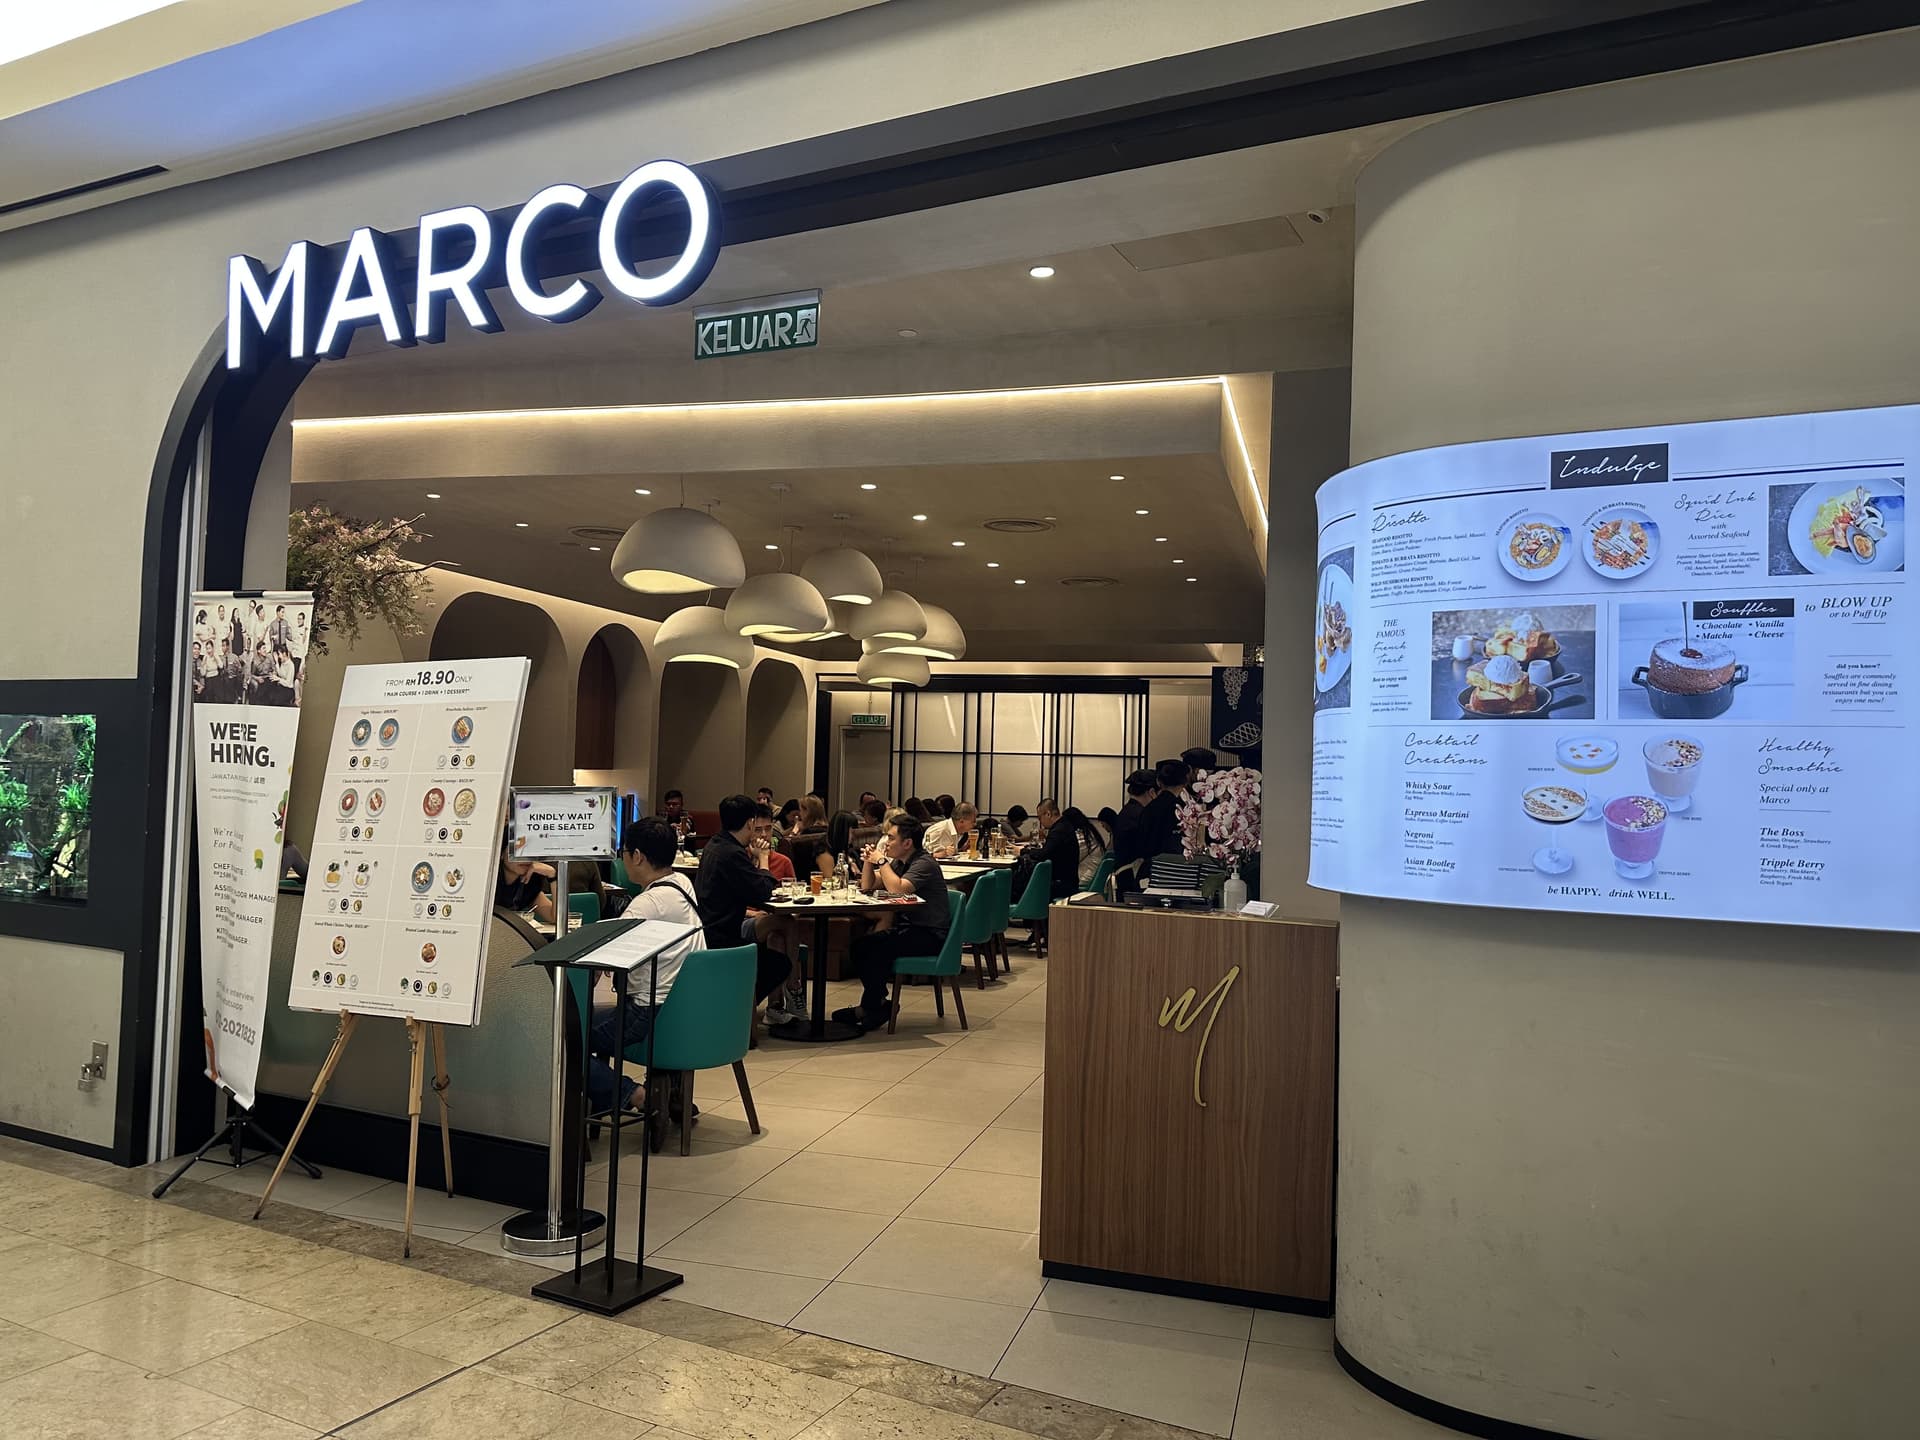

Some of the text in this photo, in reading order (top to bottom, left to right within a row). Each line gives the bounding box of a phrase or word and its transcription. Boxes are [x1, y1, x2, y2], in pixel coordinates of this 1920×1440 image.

[227, 159, 712, 370] MARCO
[697, 312, 792, 356] KELUAR
[1559, 454, 1661, 481] Indulge
[1675, 490, 1756, 511] Squid Ink
[1694, 508, 1736, 522] Rice
[1371, 510, 1430, 533] Risotto
[1711, 522, 1727, 530] with
[1688, 530, 1750, 541] Assorted Seafood
[1710, 602, 1777, 617] Souffles
[1805, 596, 1893, 612] to BLOW UP
[1841, 610, 1850, 618] to
[1852, 609, 1872, 619] Puff
[1874, 609, 1887, 619] Up
[1383, 619, 1398, 627] THE
[1701, 620, 1784, 630] Chocolate Vanilla
[1376, 629, 1405, 638] FAMOUS
[1702, 631, 1784, 640] Matcha Cheese
[1373, 641, 1407, 653] French
[1404, 732, 1479, 747] Cocktail
[1758, 737, 1835, 758] Healthy
[1404, 750, 1488, 765] Creations
[1758, 758, 1843, 774] Smoothie
[1405, 781, 1452, 791] Whisky Sour
[1760, 783, 1829, 795] Special only at
[1759, 796, 1790, 805] Marco
[530, 813, 564, 821] KINDLY
[1404, 809, 1470, 819] Espresso Martini
[527, 823, 595, 831] TO BE SEATED
[1760, 827, 1804, 837] The Boss
[1405, 830, 1434, 839] Negroni
[213, 862, 231, 870] CHEF
[1404, 857, 1456, 869] Asian Bootleg
[1760, 858, 1825, 870] Tripple Berry
[1547, 886, 1675, 901] be HAPPY. drink WELL.
